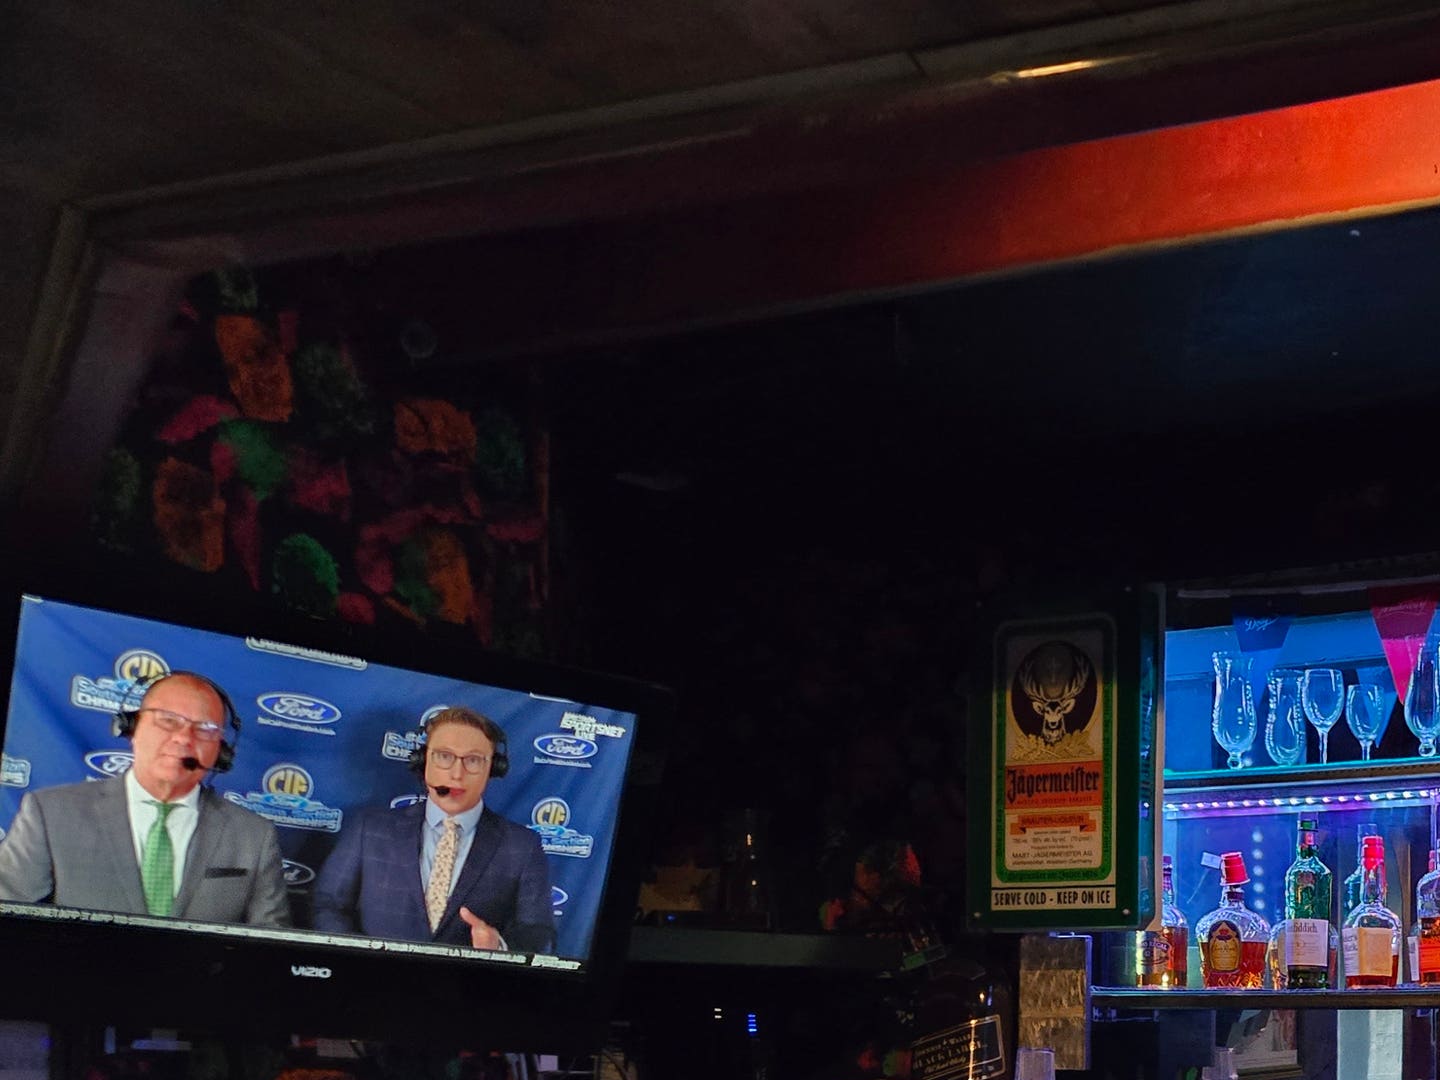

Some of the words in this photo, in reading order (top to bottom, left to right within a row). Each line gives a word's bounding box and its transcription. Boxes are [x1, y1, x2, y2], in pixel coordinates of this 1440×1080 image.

[995, 892, 1021, 906] SERVE
[1024, 891, 1046, 905] COLD
[1057, 890, 1078, 905] KEEP
[1081, 890, 1094, 904] ON
[1096, 890, 1110, 903] ICE
[291, 965, 333, 979] VIZIO
